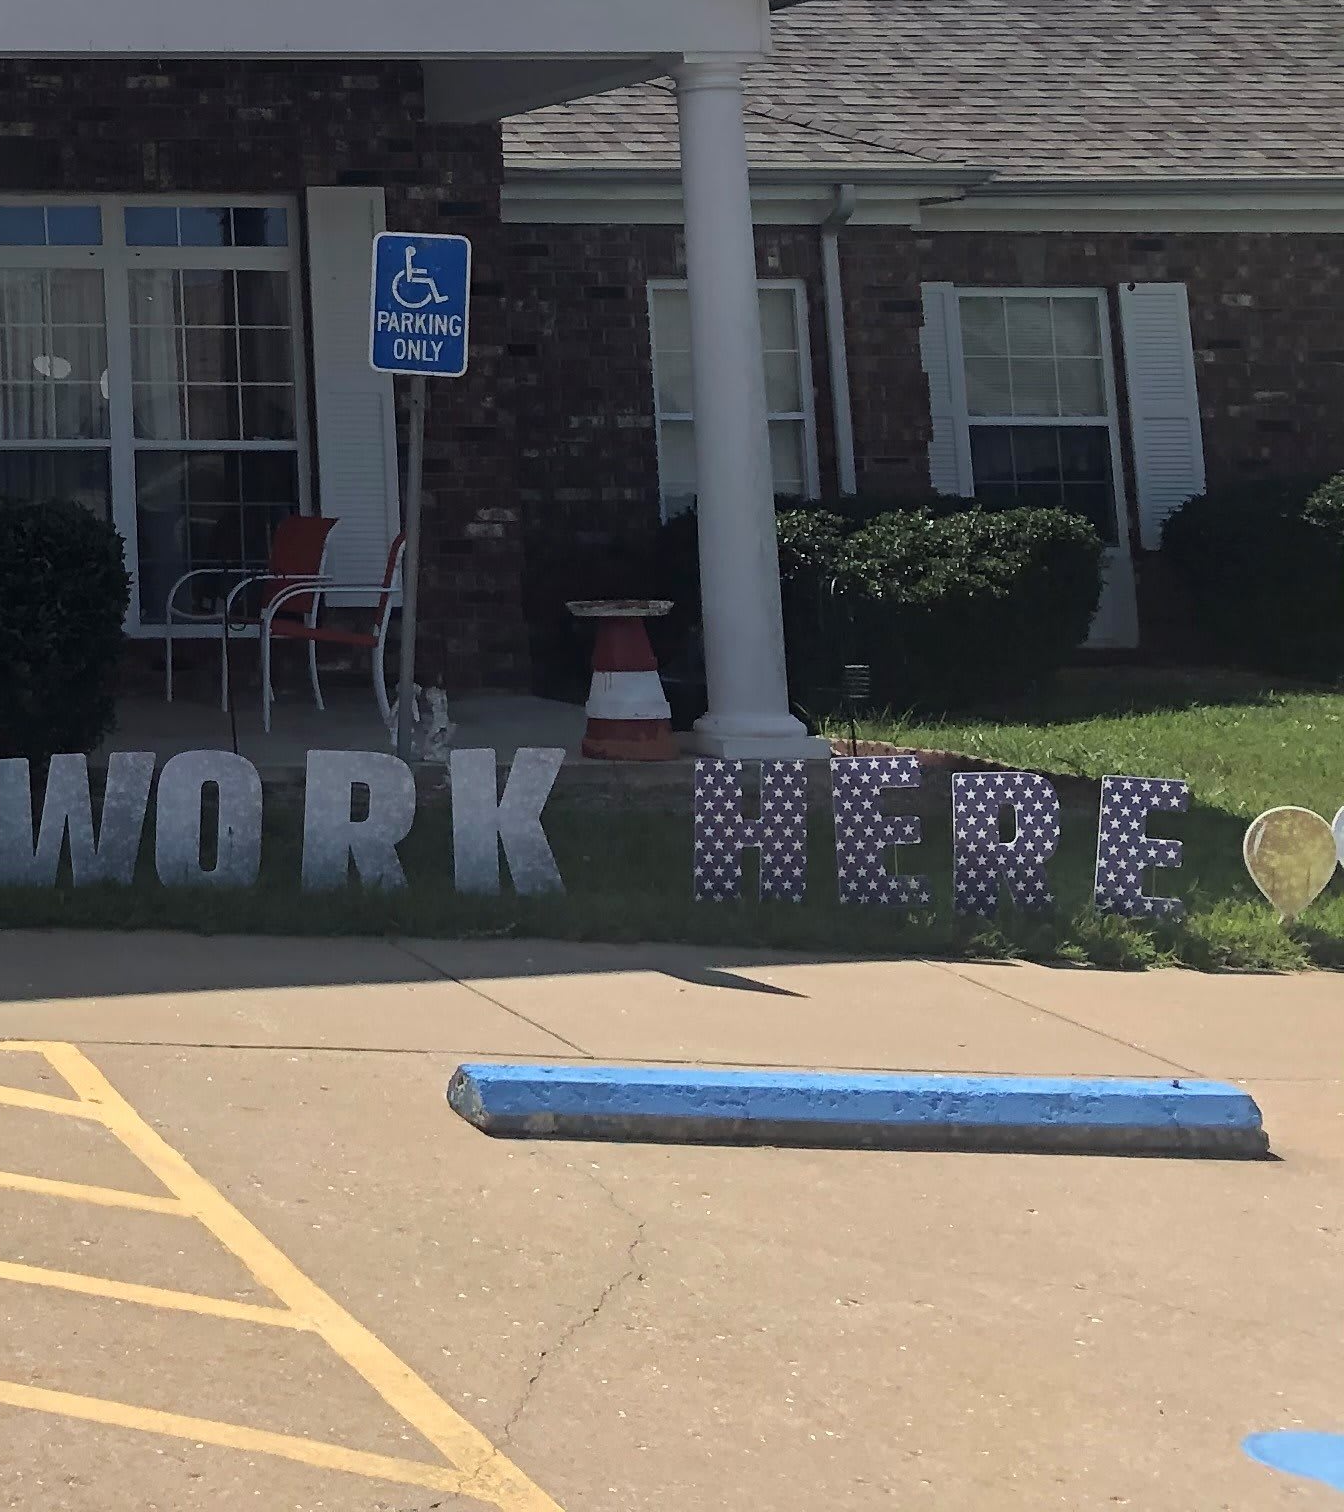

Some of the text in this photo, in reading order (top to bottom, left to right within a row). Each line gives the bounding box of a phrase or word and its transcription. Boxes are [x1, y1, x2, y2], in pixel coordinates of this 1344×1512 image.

[376, 310, 463, 337] PARKING
[393, 338, 444, 363] ONLY
[693, 753, 1191, 920] HERE
